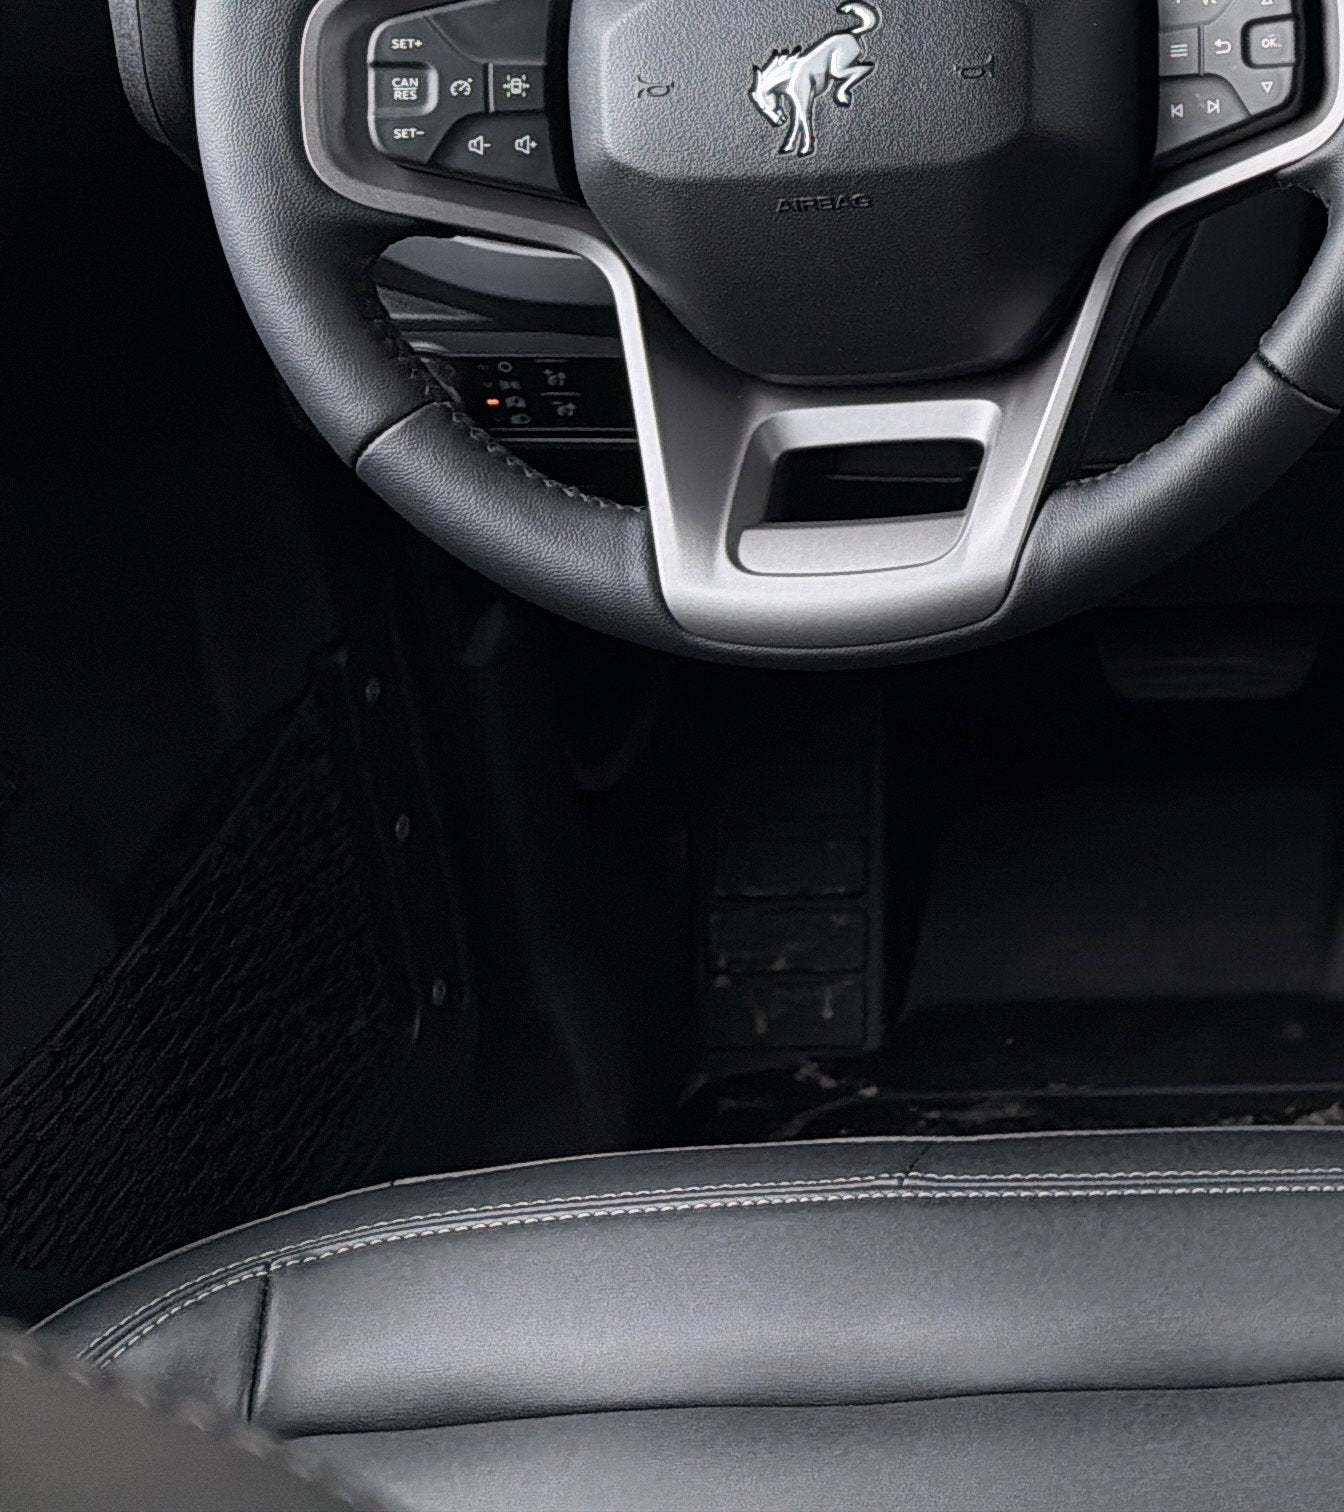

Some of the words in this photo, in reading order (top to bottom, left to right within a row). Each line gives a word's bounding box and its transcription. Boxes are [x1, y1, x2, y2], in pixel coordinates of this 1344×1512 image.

[391, 38, 423, 49] SET+
[391, 77, 419, 88] CAN
[393, 90, 418, 100] RES
[776, 193, 870, 213] AIRBAG
